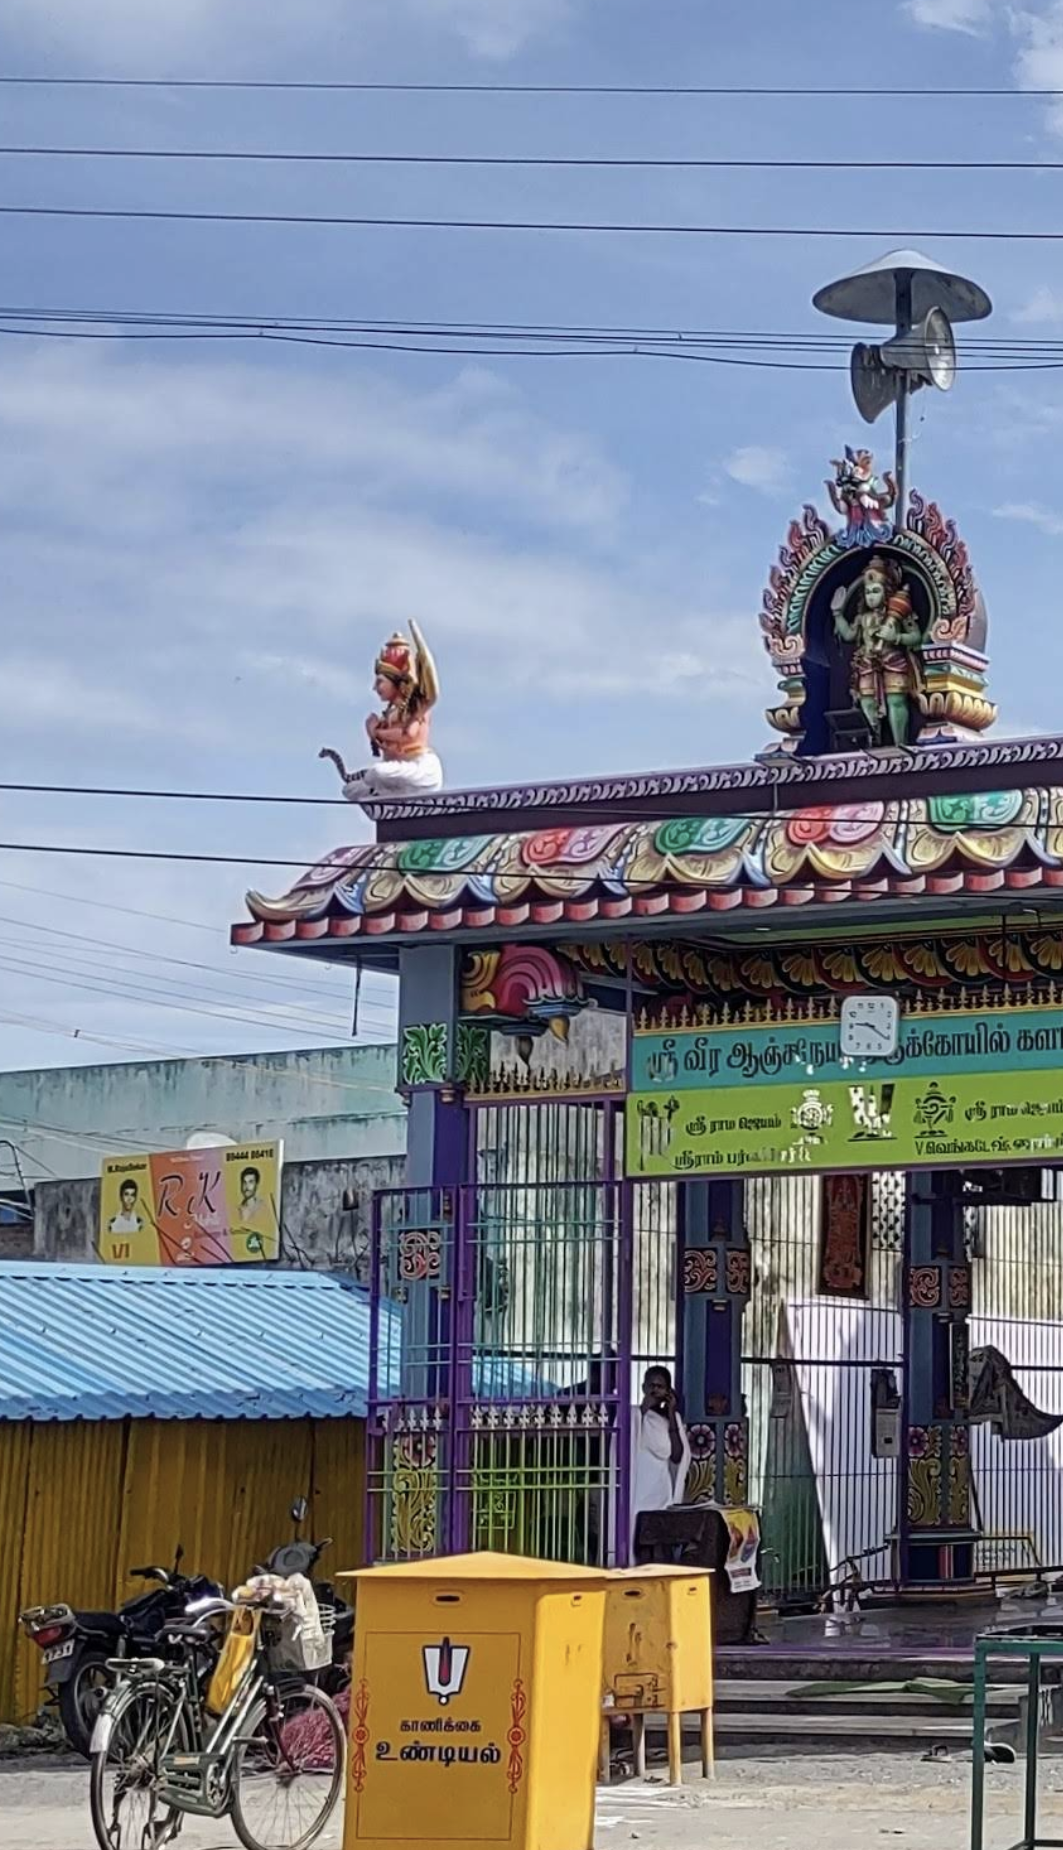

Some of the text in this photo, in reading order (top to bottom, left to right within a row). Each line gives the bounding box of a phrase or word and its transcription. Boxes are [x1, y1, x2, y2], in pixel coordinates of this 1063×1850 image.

[648, 1038, 678, 1082] ஸ்ரீ
[684, 1036, 722, 1077] வீர
[727, 1036, 841, 1078] ஆஞ்சநேய
[685, 1113, 782, 1136] ஸ்ரீ ராம ஜெயம்
[400, 1717, 482, 1733] காணிக்கை
[375, 1740, 501, 1767] உண்டியல்
